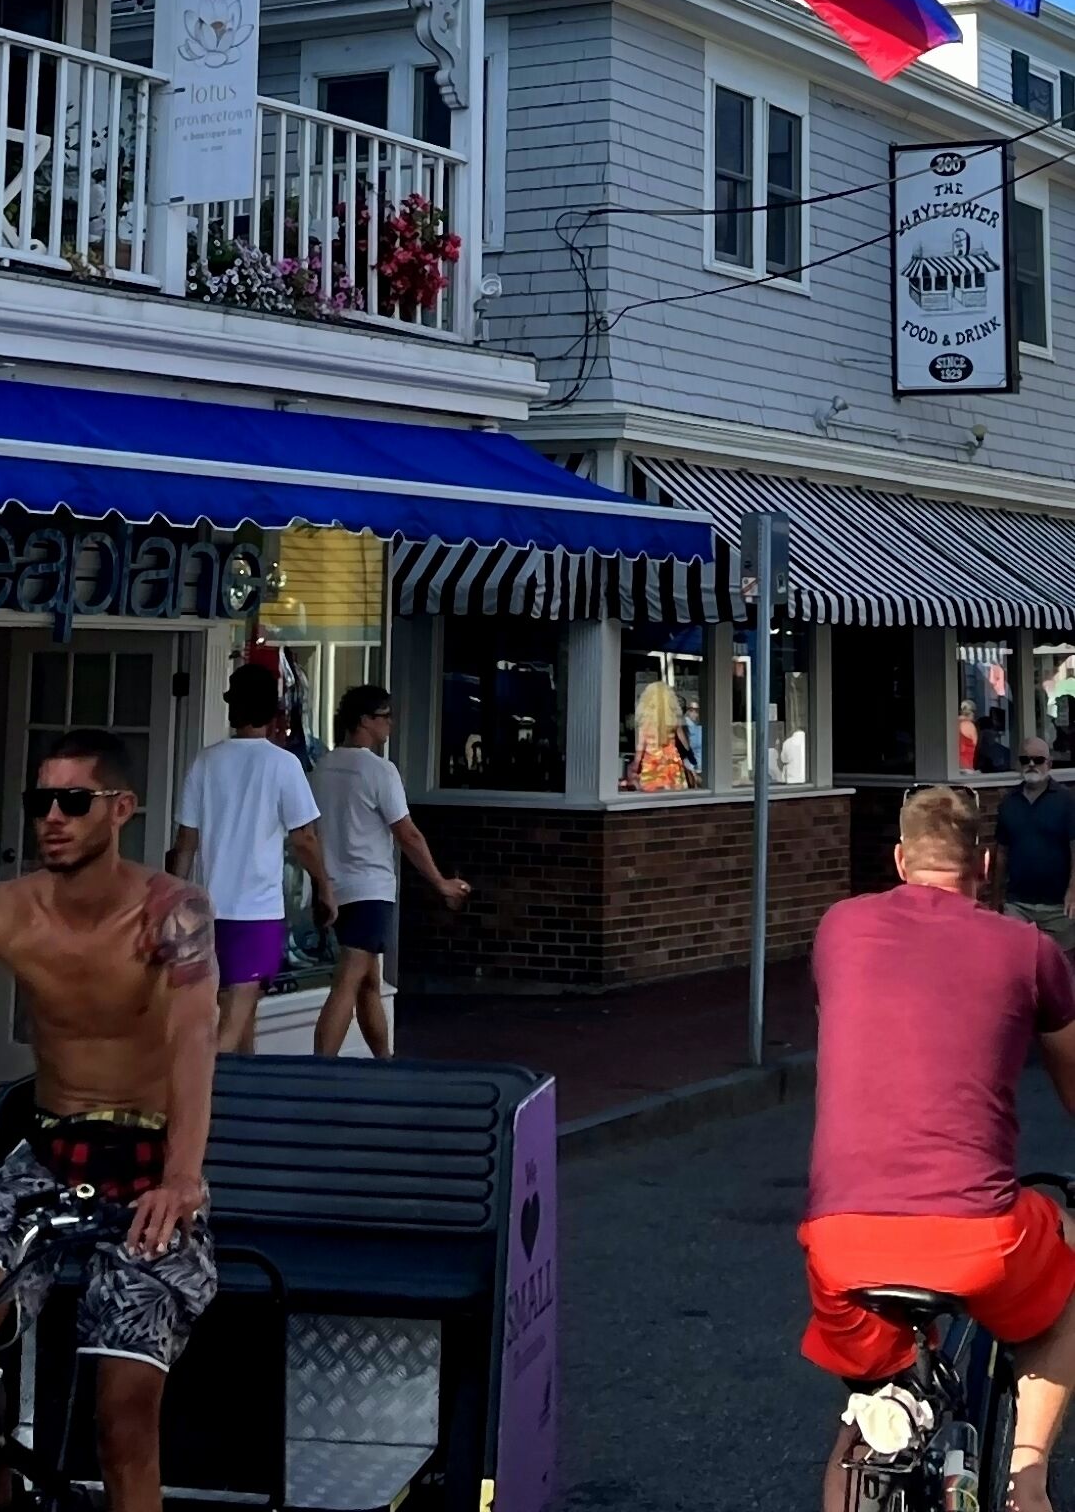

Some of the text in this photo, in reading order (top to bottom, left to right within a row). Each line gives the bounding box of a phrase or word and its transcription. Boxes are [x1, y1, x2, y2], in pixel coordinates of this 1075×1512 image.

[190, 82, 237, 105] lotus
[174, 108, 253, 131] provincetown
[934, 182, 964, 197] THE
[899, 200, 1000, 237] MAYFLOWER
[901, 316, 1002, 347] FOOD & DRINK
[935, 356, 967, 370] SINCE
[939, 369, 964, 381] 1929
